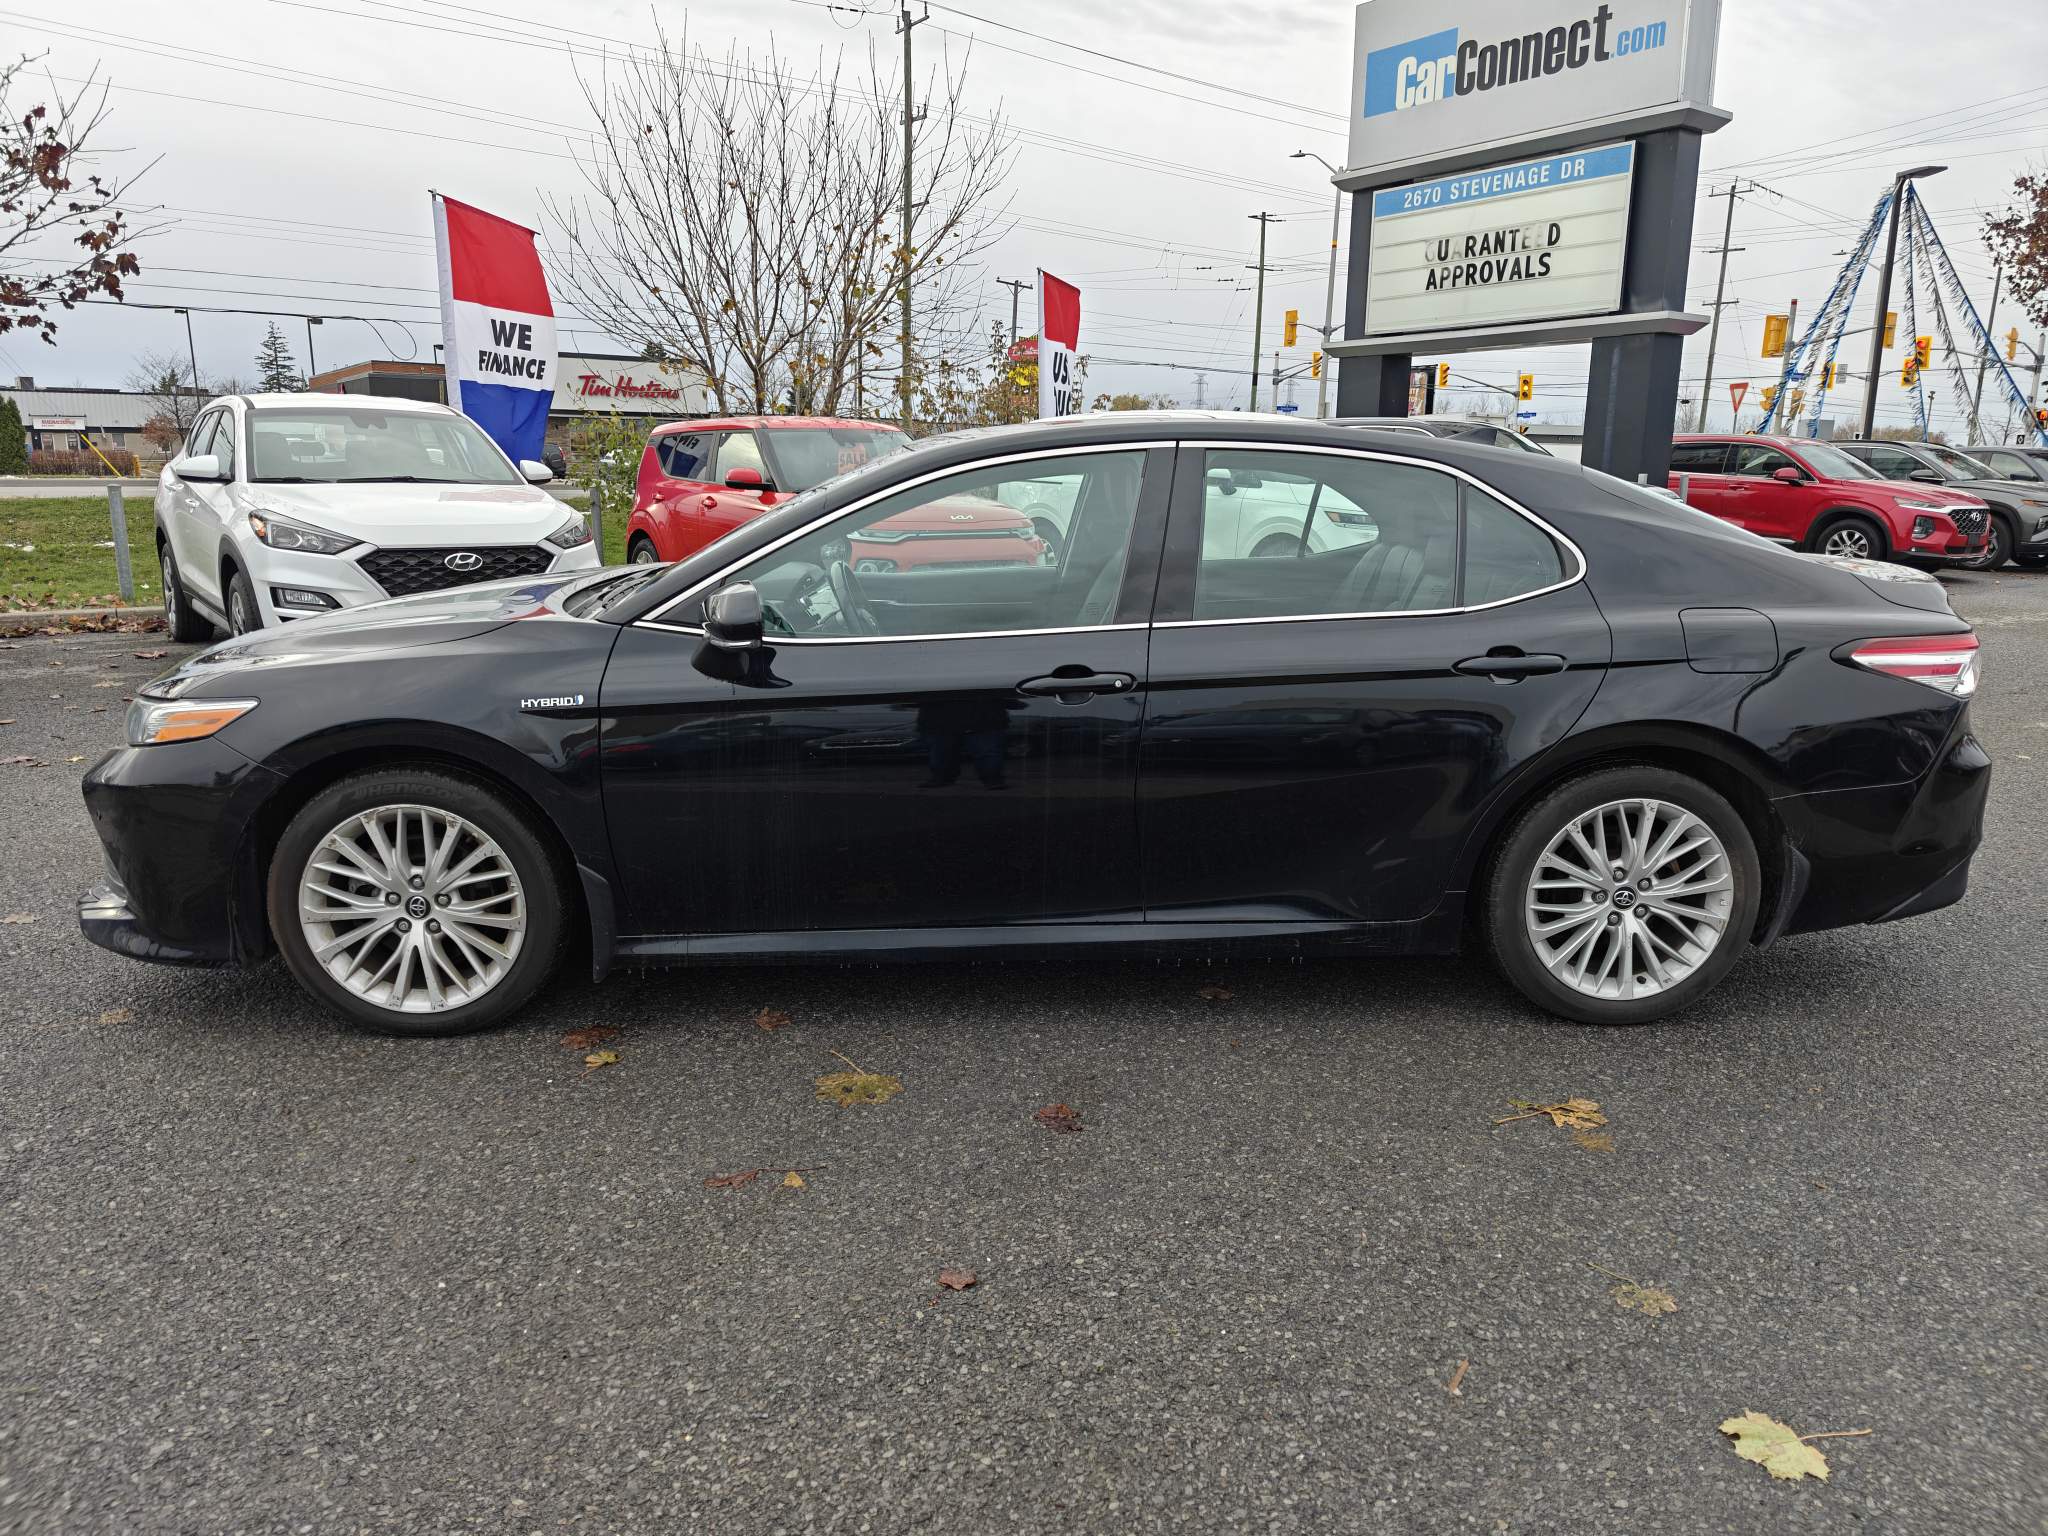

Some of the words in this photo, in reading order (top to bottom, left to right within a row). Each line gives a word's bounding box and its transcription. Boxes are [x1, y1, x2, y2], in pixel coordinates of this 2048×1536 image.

[1403, 186, 1442, 208] 2670
[1450, 164, 1550, 200] STEVENAGE
[1560, 158, 1586, 179] DR
[1425, 252, 1552, 291] APPROVALS
[490, 318, 532, 351] WE
[478, 349, 547, 380] FINANCE
[578, 375, 612, 397] Tim
[614, 375, 680, 400] Hortons
[839, 451, 866, 465] SALE
[521, 697, 575, 708] HYBRID
